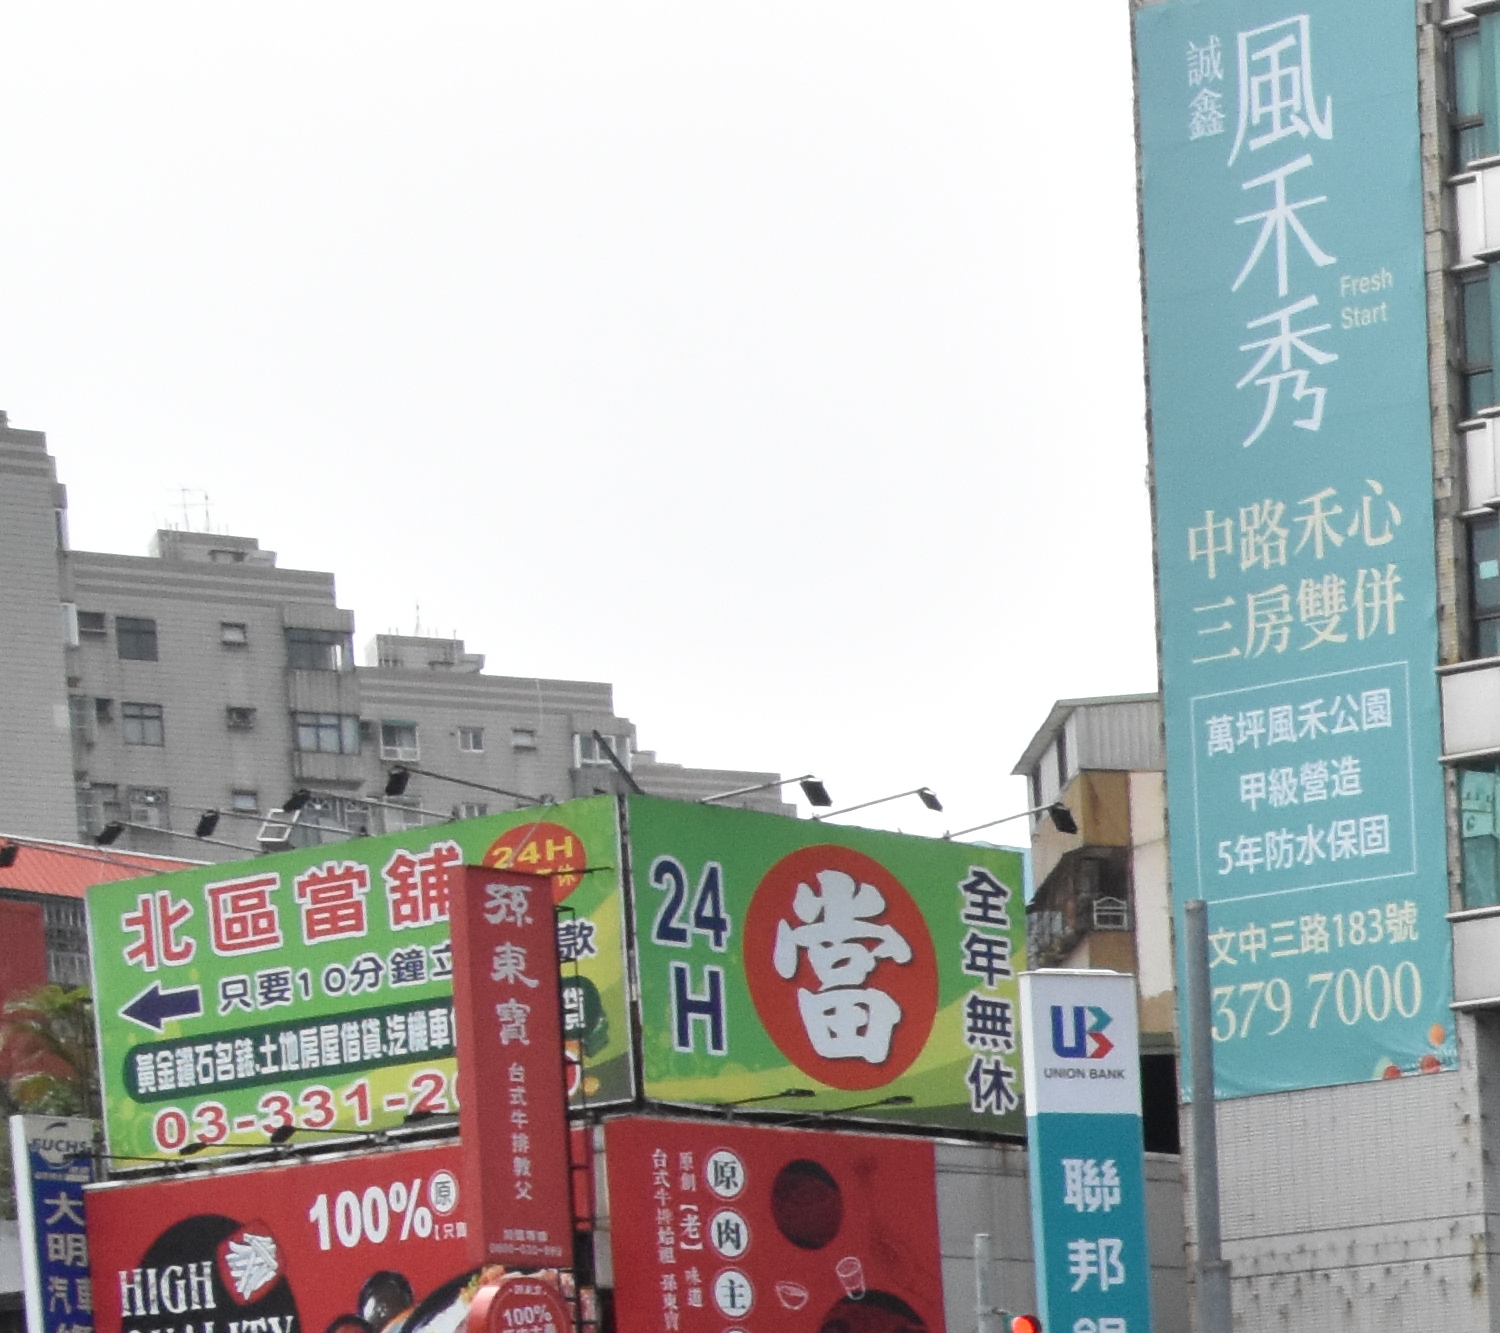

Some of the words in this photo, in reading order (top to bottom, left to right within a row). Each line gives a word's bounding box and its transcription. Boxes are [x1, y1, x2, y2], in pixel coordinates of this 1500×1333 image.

[1187, 36, 1225, 141] 誠鑫
[1227, 14, 1339, 448] 風禾秀
[1340, 269, 1394, 295] Fresh
[1341, 302, 1389, 330] Start
[1186, 478, 1403, 584] 中路禾心
[1190, 570, 1405, 668] 三房雙併
[1205, 688, 1393, 757] 萬坪風禾公園
[1238, 757, 1363, 813] 甲級營造
[492, 834, 575, 869] 24H
[1215, 814, 1391, 878] 5年防水保固
[121, 839, 464, 971] 北區當舖
[649, 856, 729, 949] 24
[1207, 902, 1421, 971] 文中三路183號
[770, 866, 912, 1066] 當
[957, 866, 1021, 1115] 全年無休
[1210, 976, 1290, 1043] 379
[1305, 960, 1424, 1028] 7000
[669, 965, 725, 1055] H
[1044, 1067, 1081, 1079] UNION
[1084, 1067, 1126, 1080] BANK
[308, 1178, 433, 1252] 100%
[119, 1260, 217, 1318] HIGH
[503, 1305, 553, 1327] 100%
